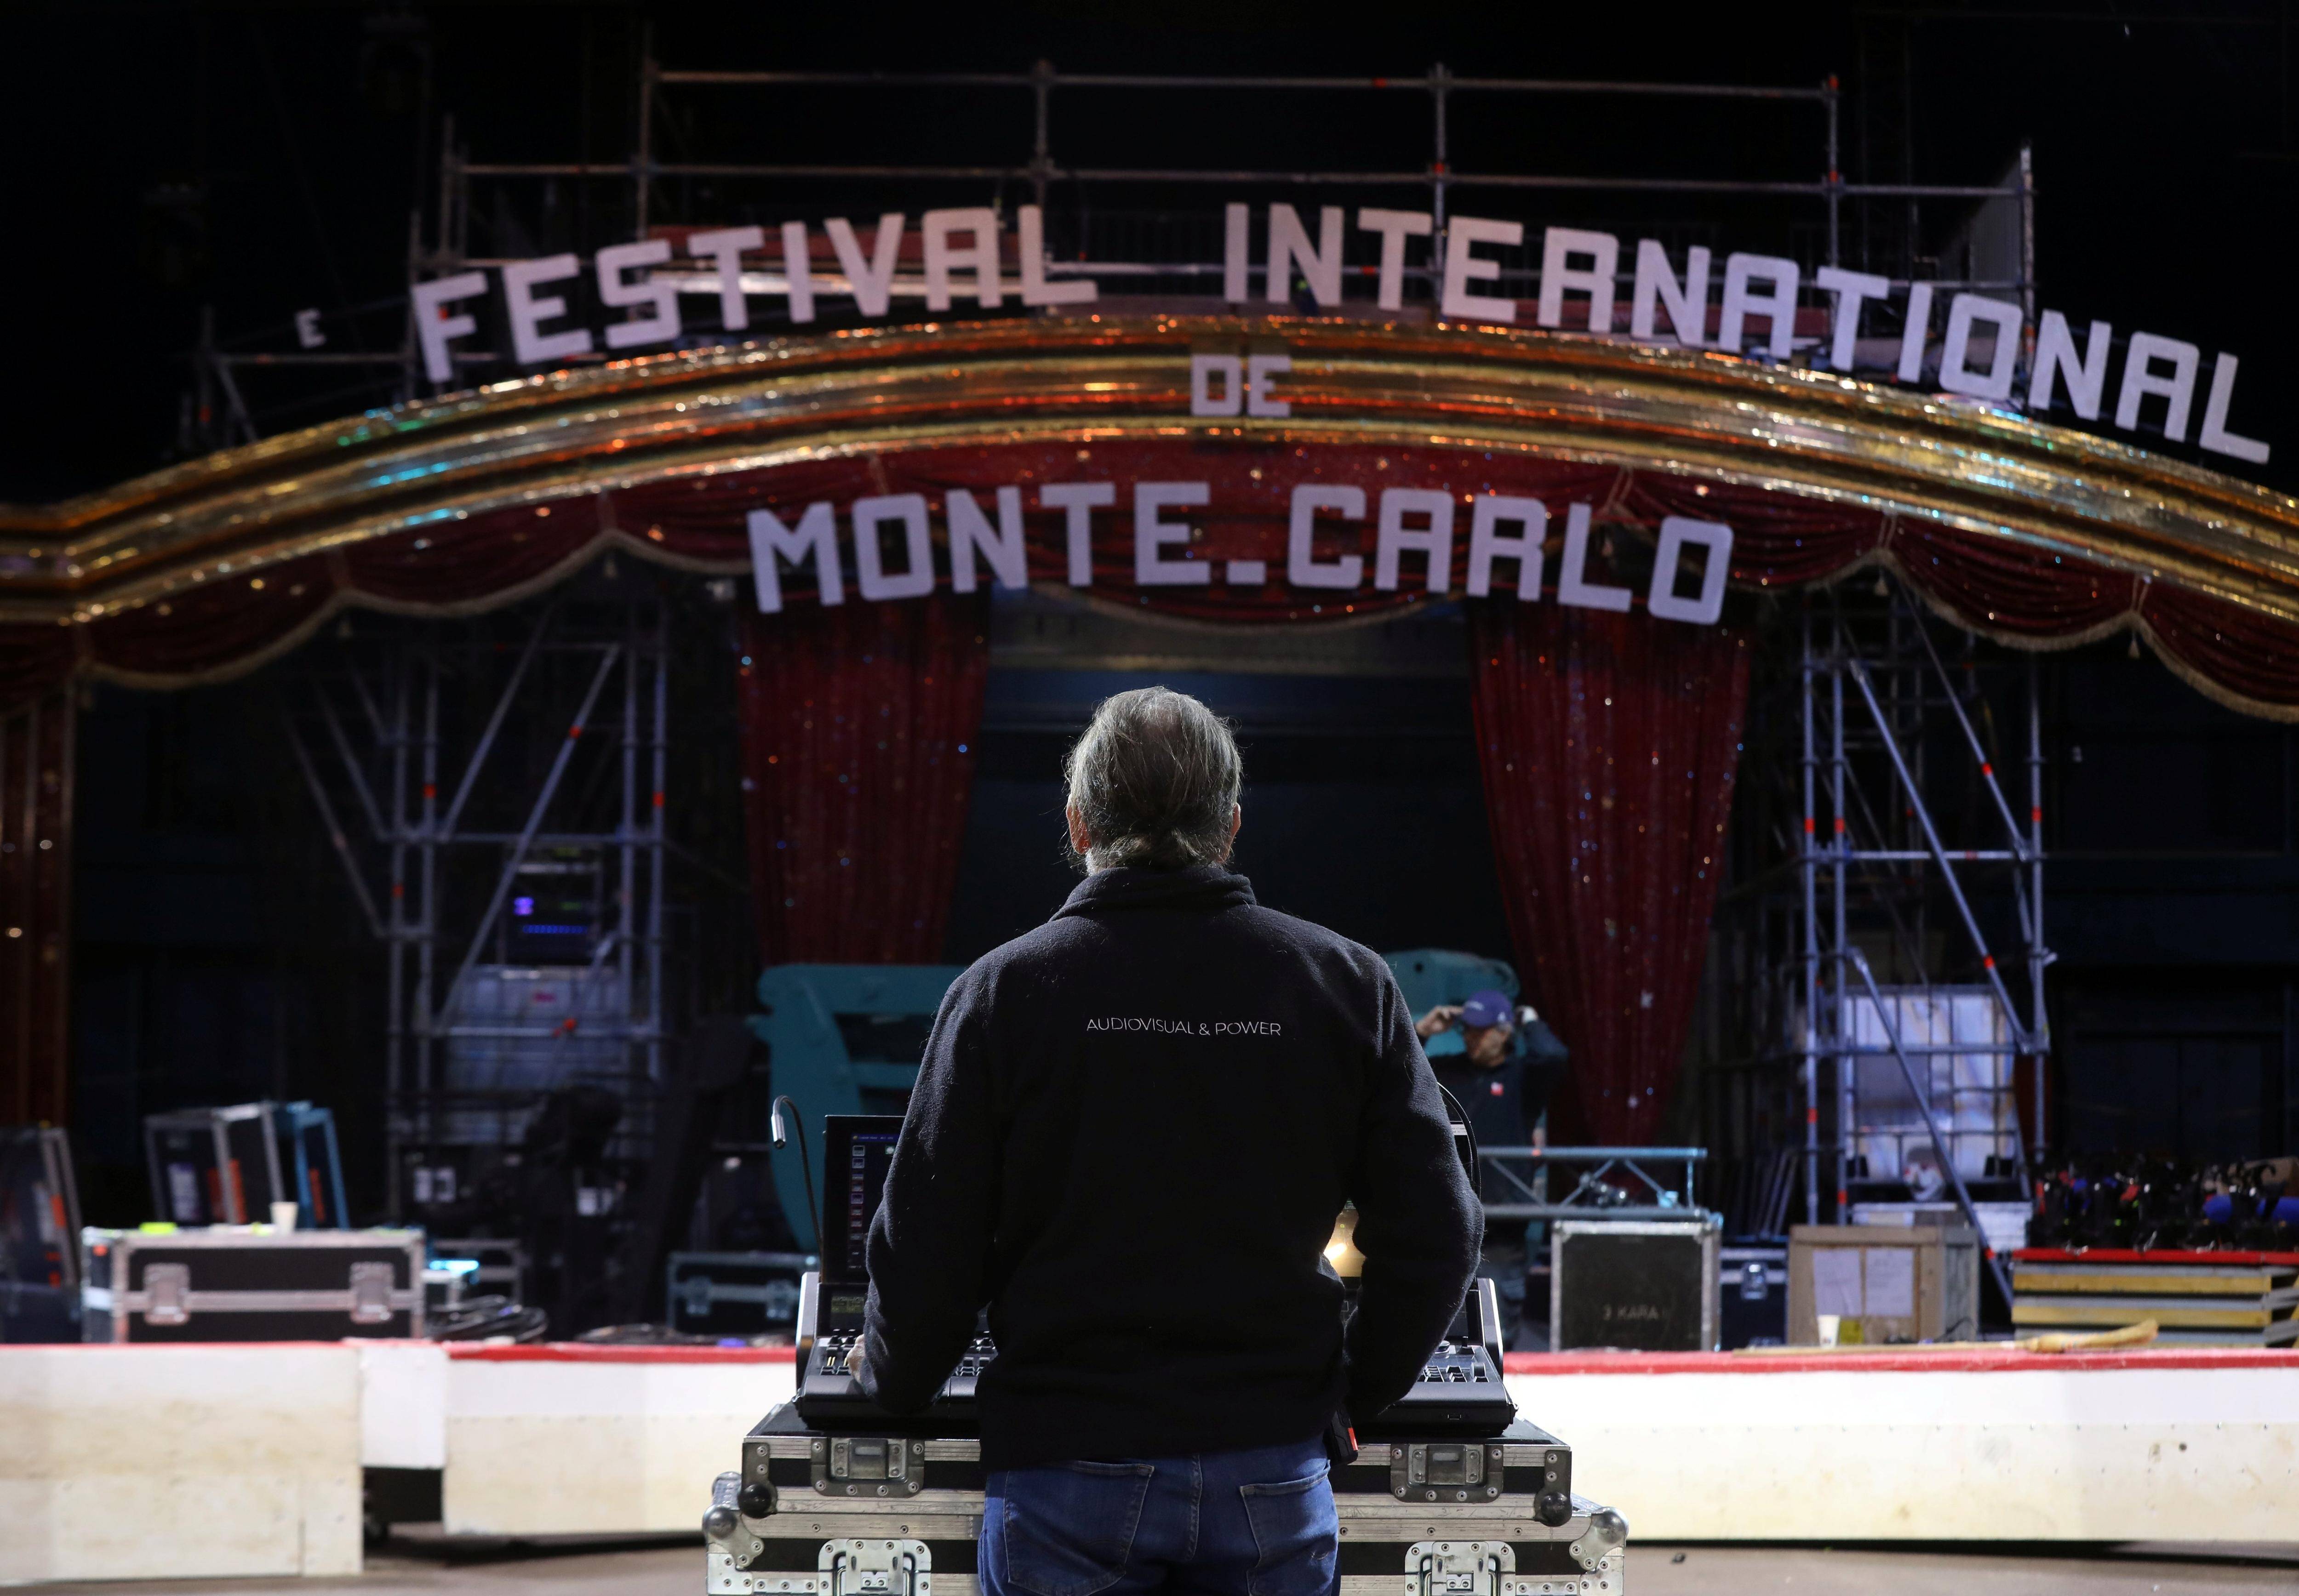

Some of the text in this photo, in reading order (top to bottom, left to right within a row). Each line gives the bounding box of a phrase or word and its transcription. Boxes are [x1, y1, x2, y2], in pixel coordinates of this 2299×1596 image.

[294, 202, 2270, 461] E FESTIVAL INTERNATIONAL
[1190, 354, 1291, 417] DE
[1087, 1018, 1281, 1036] AUDIOVISUAL & POWER
